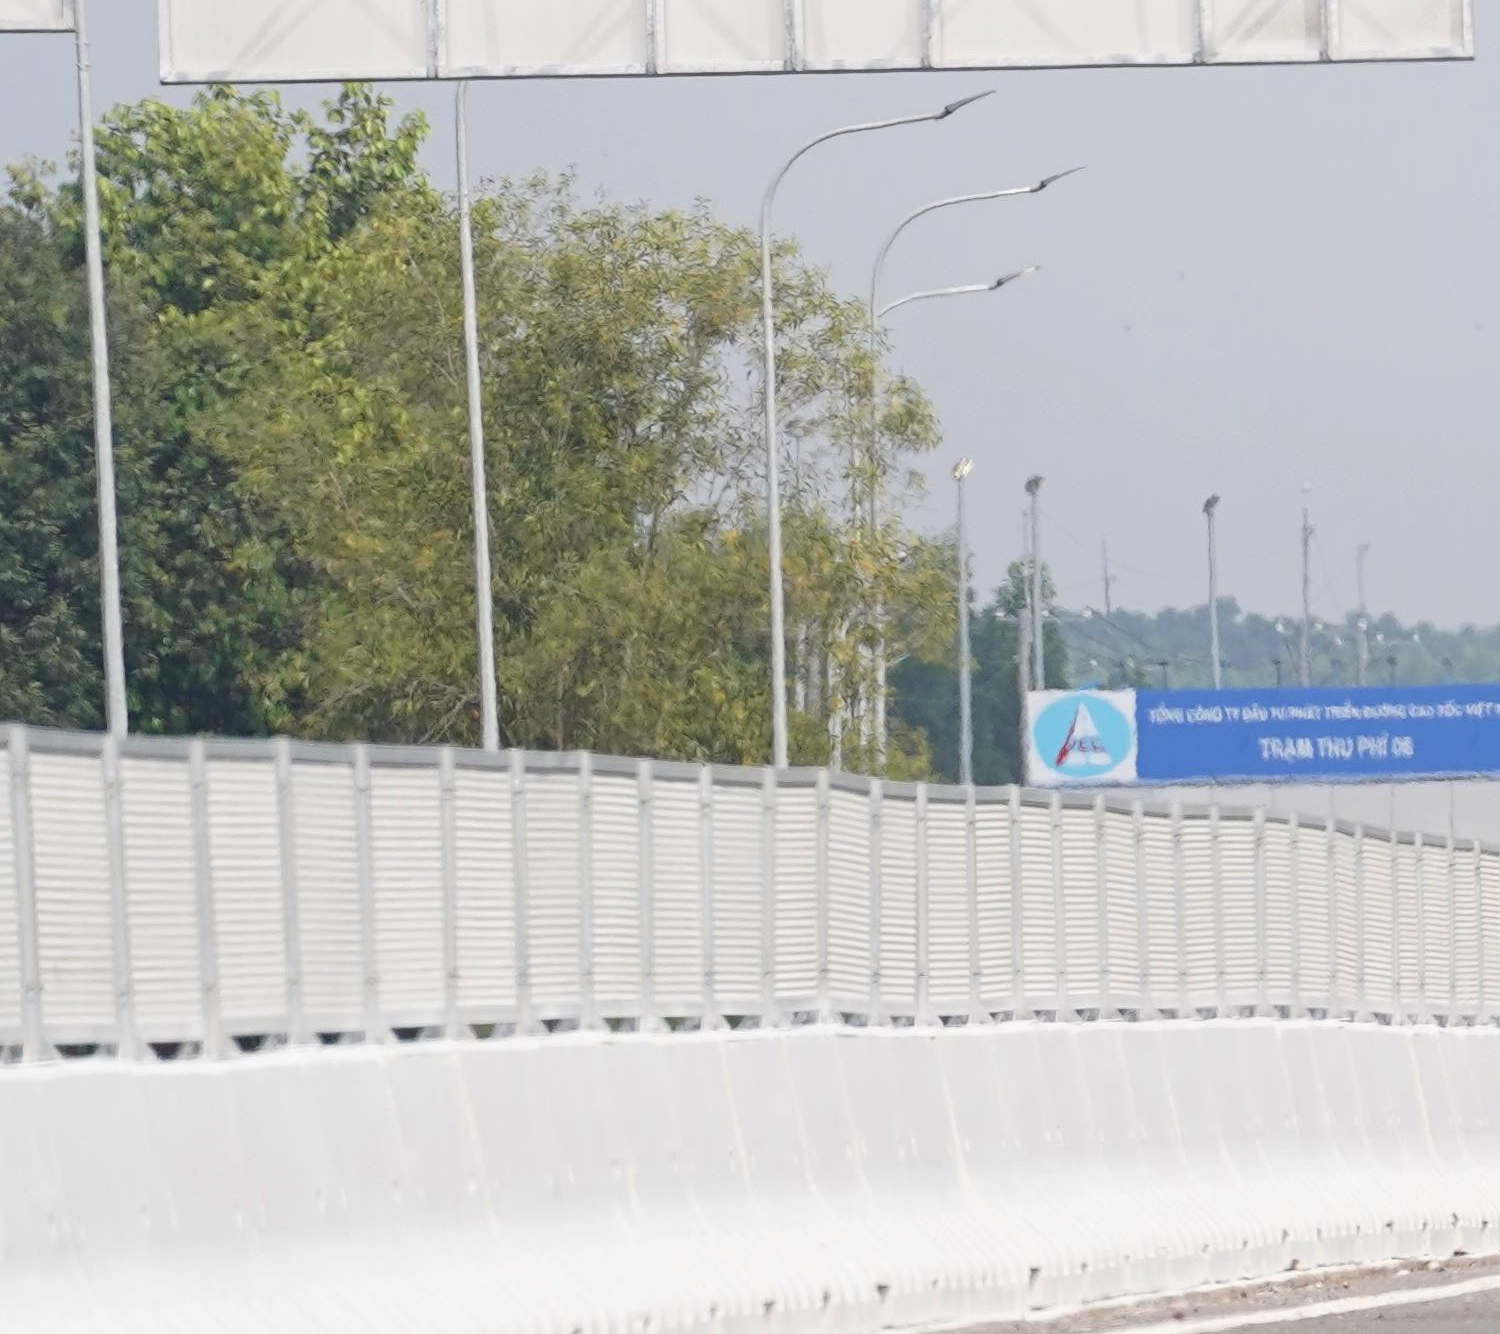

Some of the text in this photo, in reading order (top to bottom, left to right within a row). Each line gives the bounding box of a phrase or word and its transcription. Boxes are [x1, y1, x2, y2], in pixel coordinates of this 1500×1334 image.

[1258, 735, 1315, 764] TRẠM
[1317, 736, 1355, 760] THU
[1356, 730, 1390, 760] PHÍ
